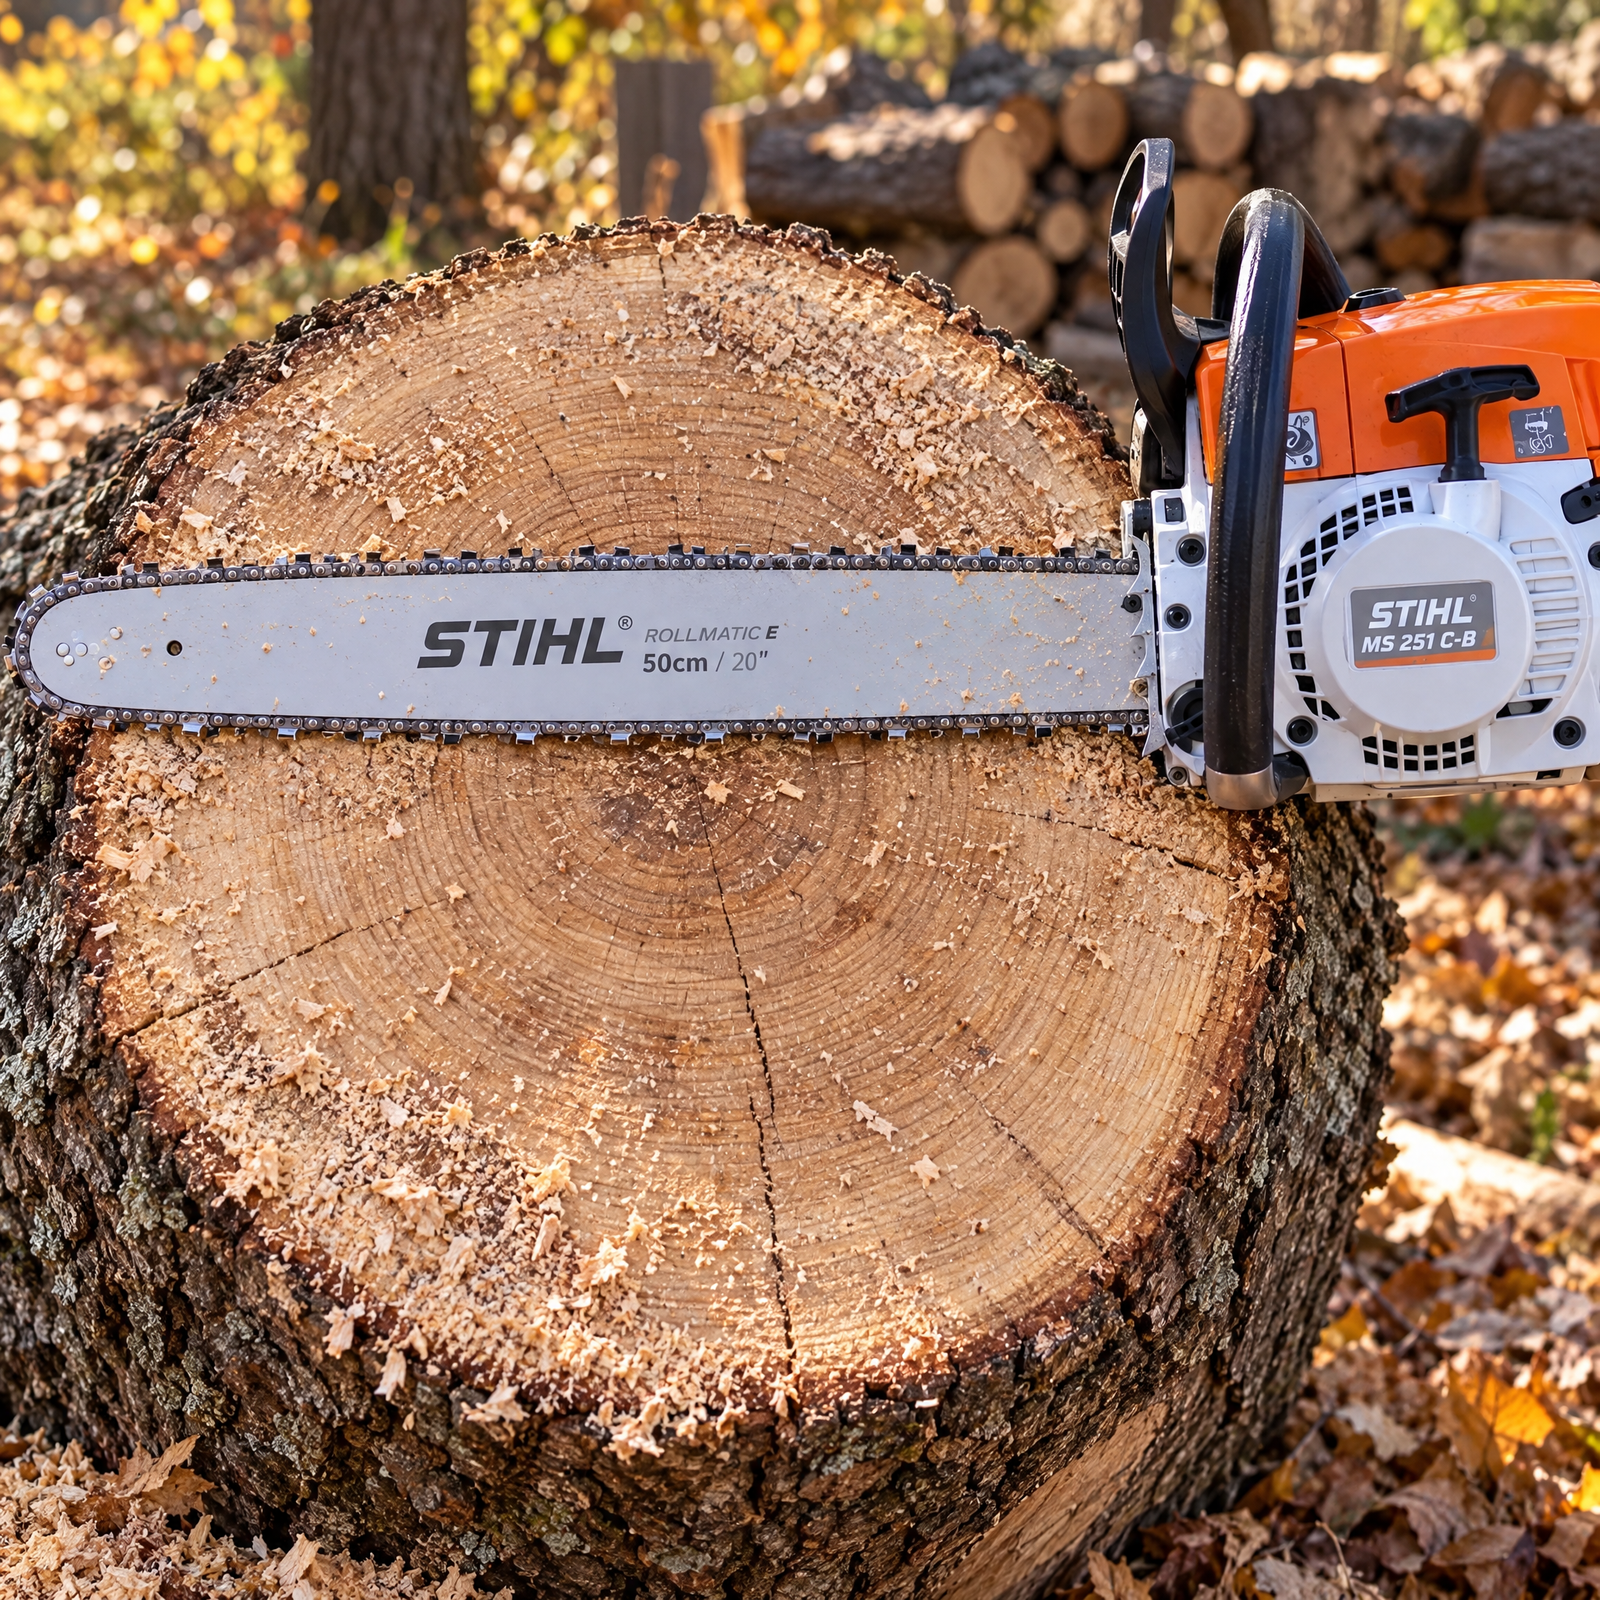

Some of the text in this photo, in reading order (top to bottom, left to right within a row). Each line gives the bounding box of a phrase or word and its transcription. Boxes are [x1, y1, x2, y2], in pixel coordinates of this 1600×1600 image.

[644, 625, 780, 643] ROLLMATIC E
[1361, 630, 1477, 653] MS 251 C-B
[642, 653, 708, 673] 50cm
